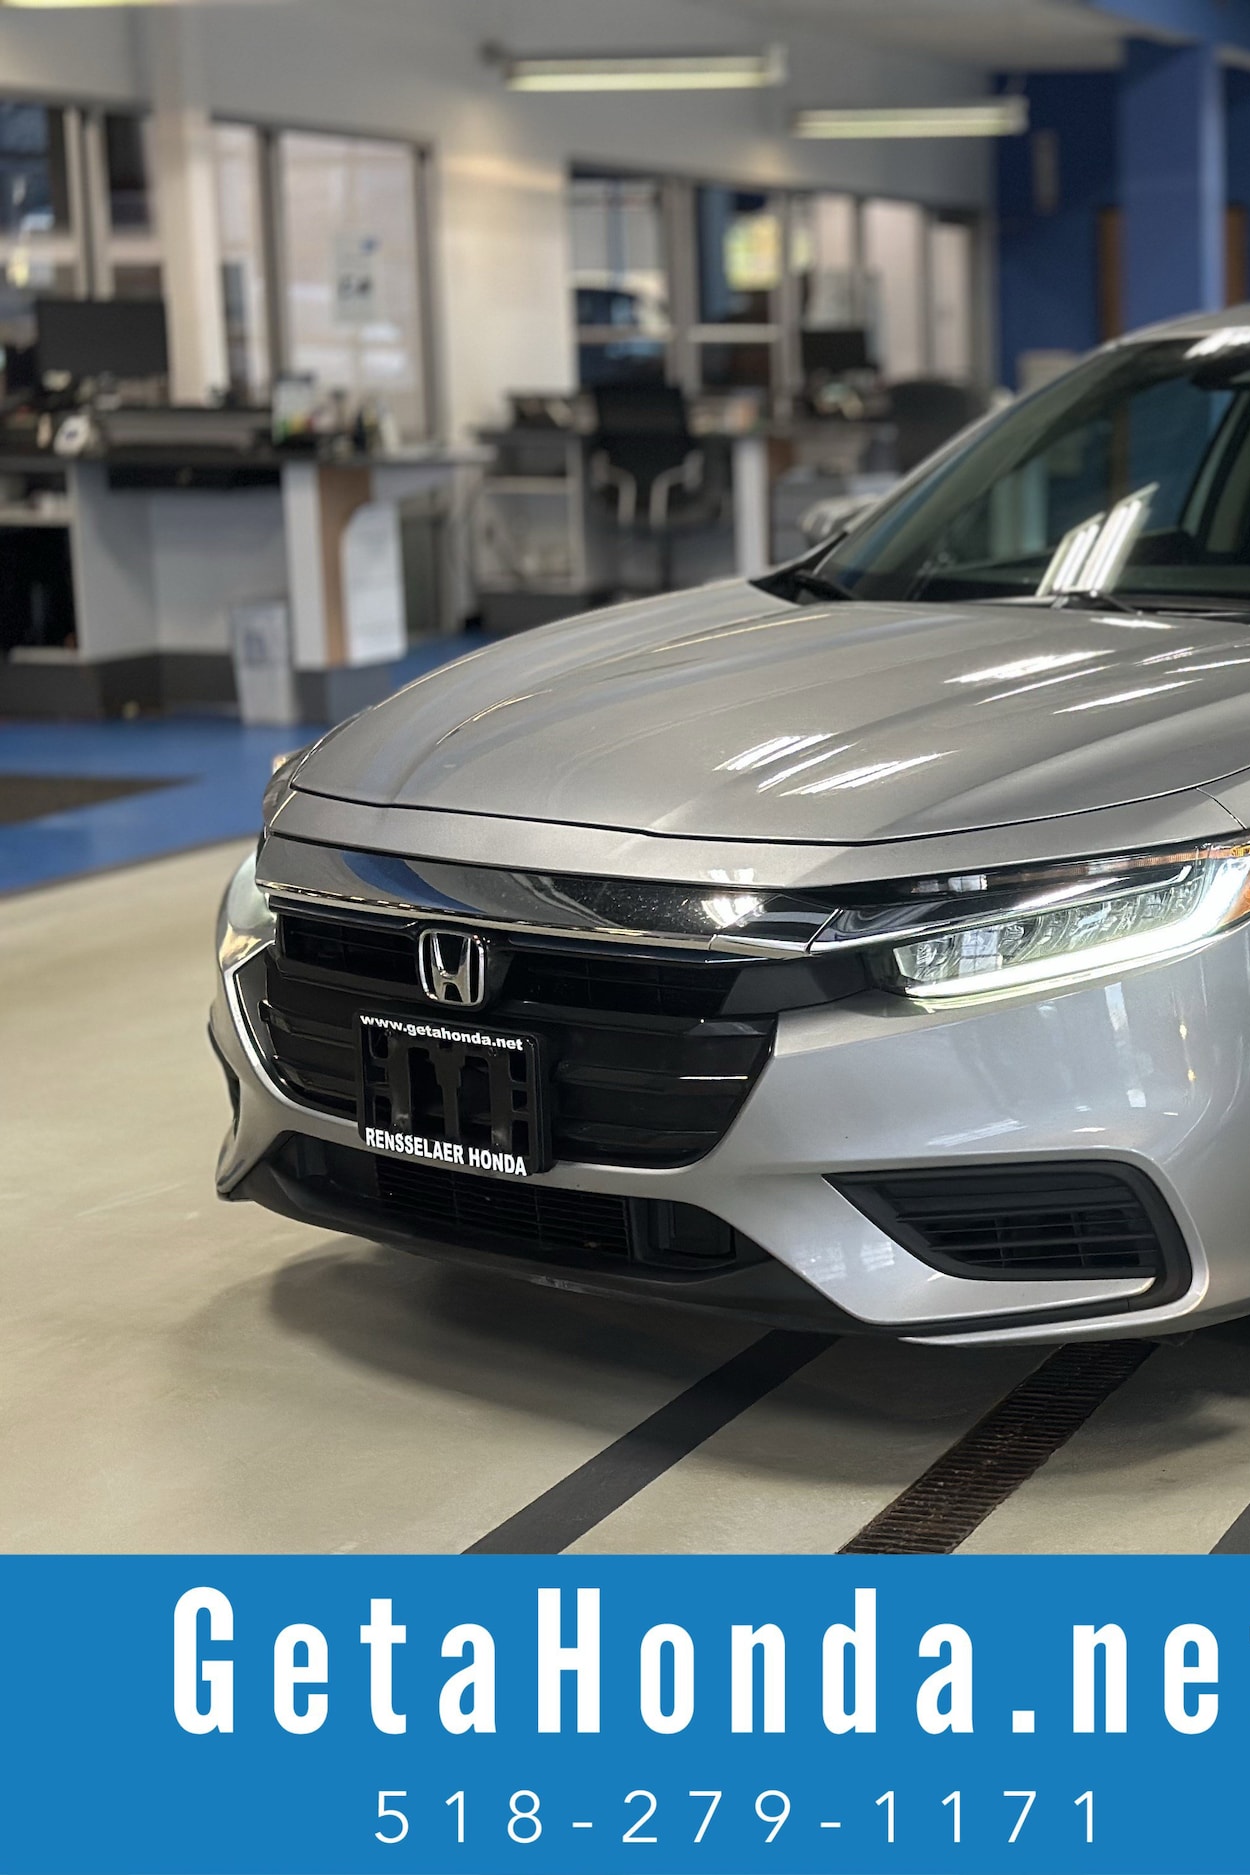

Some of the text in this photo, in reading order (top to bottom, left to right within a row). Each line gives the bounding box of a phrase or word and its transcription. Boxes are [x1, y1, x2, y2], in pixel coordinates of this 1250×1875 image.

[360, 1015, 523, 1051] www.getahonda.net
[365, 1127, 527, 1176] RENSSELAER HONDA
